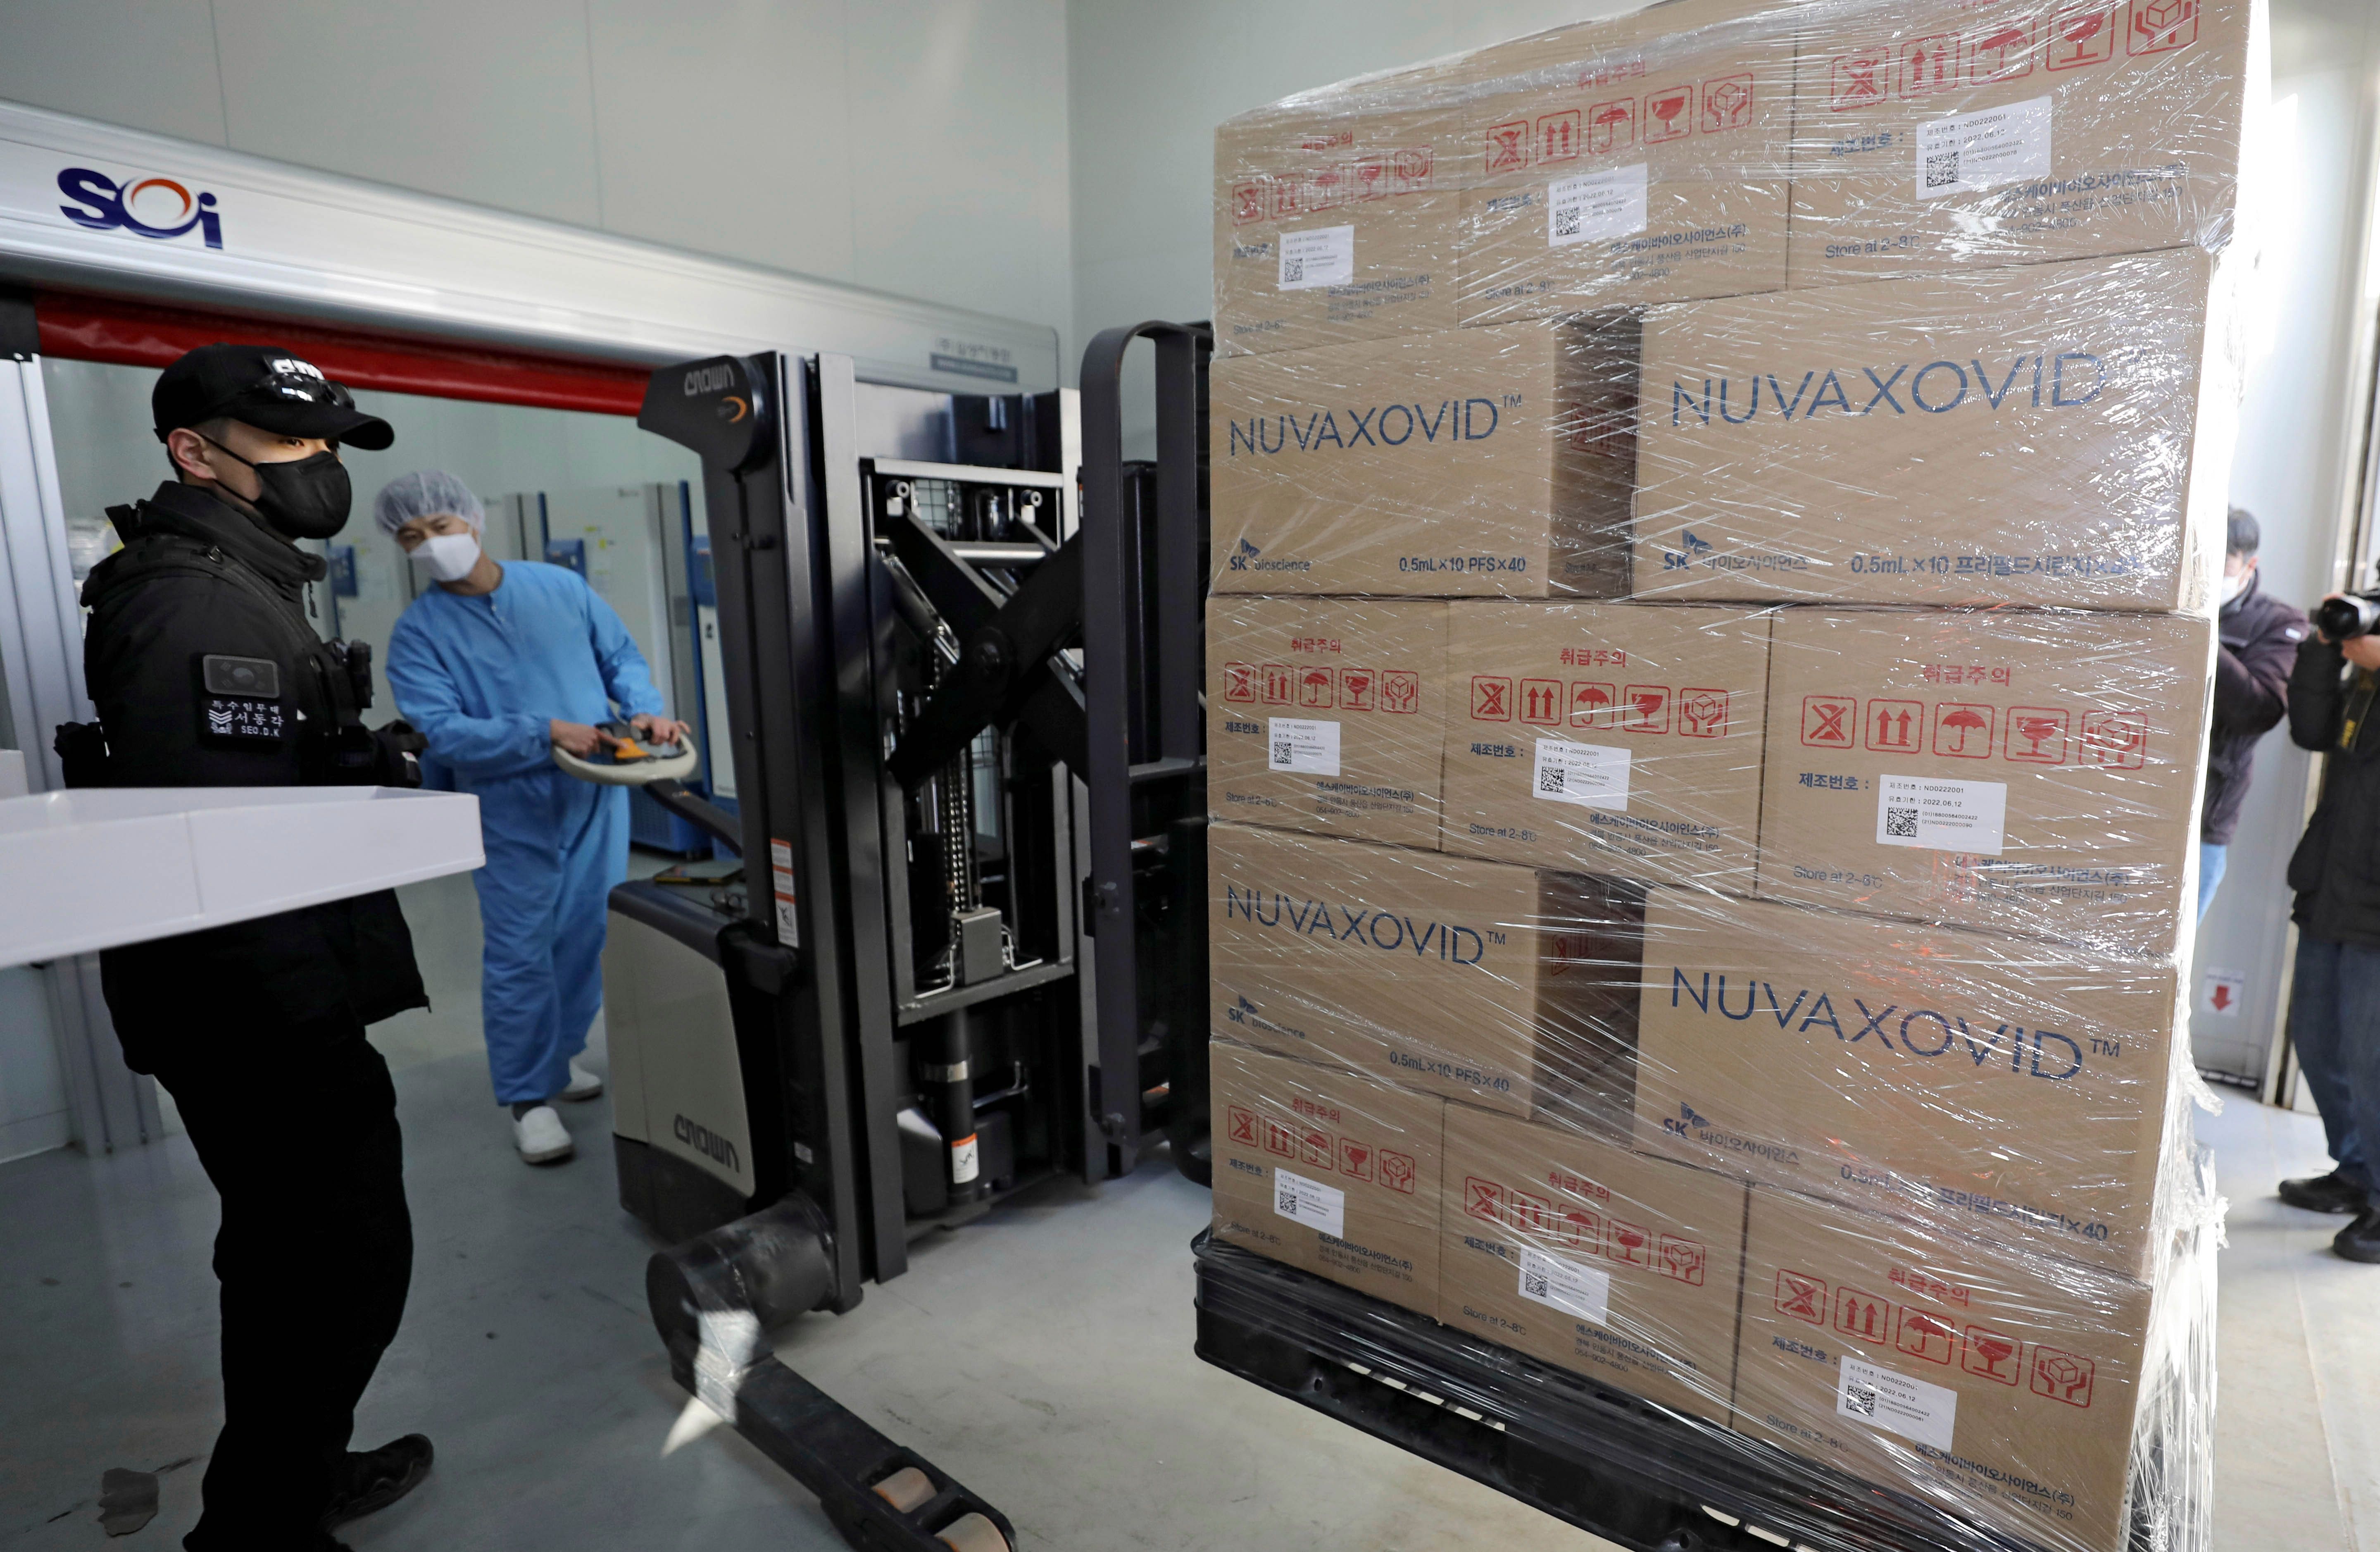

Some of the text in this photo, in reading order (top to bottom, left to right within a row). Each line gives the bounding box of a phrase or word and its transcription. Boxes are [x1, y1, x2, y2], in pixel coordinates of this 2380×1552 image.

[1825, 244, 1861, 258] Store
[1865, 240, 1878, 252] at
[1672, 353, 2108, 427] NUVAXOVID
[1230, 555, 1311, 571] SK bioscience
[1663, 552, 1690, 570] SK
[1290, 638, 1342, 654] 취급주의
[1559, 648, 1626, 668] 취급주의
[1922, 663, 2011, 687] 취급주의
[1225, 721, 1260, 734] 제조번호
[1471, 743, 1516, 757] 제조번호
[1798, 772, 1859, 790] 제조번호
[1889, 782, 1964, 794] 제조번호 ND0222001
[1226, 791, 1245, 802] Store
[1247, 795, 1254, 804] at
[1888, 796, 1962, 808] 유효기한 2022.06.12
[1469, 823, 1495, 836] Store
[1497, 827, 1506, 837] at
[1793, 865, 1827, 881] Store
[1830, 872, 1843, 882] at
[2050, 885, 2105, 902] 산업단지길
[1228, 1007, 1245, 1024] SK
[1292, 1097, 1340, 1123] 취급주의
[674, 1113, 740, 1173] CROWN
[1663, 1118, 1800, 1165] SK 바이오사이언스
[1229, 1158, 1263, 1177] 제조번호
[1549, 1171, 1610, 1203] 취급주의
[1318, 1233, 1413, 1271] 에스케이바이오사이언스(주)
[1464, 1235, 1507, 1259] 제조번호
[1887, 1267, 1970, 1307] 취급주의
[1463, 1305, 1488, 1321] Store
[1490, 1316, 1498, 1325] at
[1772, 1335, 1827, 1364] 제조번호
[1880, 1386, 1916, 1402] 2022.06.12
[1766, 1415, 1797, 1433] Store
[1915, 1443, 2075, 1507] 에스케이바이오사이언스(주)
[2056, 1508, 2073, 1521] 150
